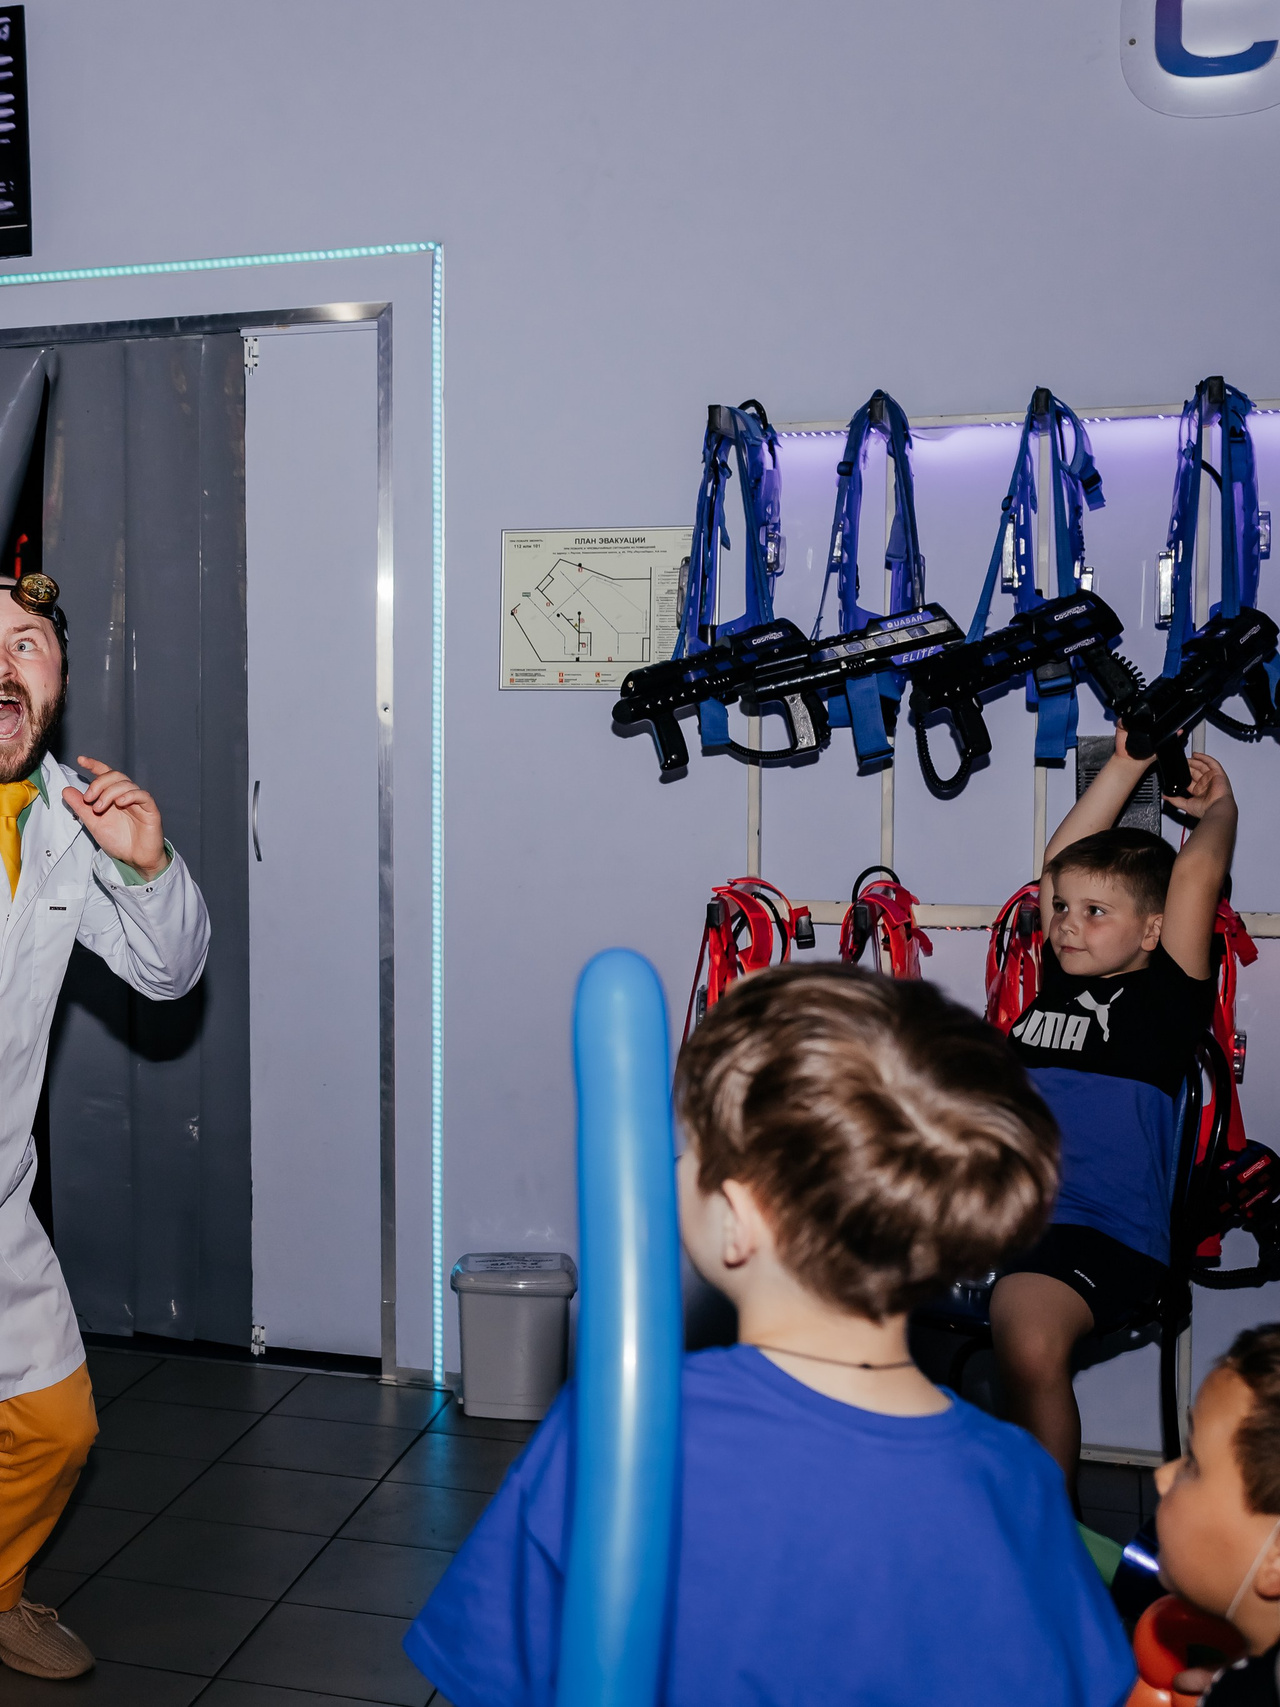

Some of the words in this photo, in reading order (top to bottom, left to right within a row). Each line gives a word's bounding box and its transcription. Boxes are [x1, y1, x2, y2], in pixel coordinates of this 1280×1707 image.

[574, 537, 598, 545] ПЛАН
[598, 536, 646, 545] ЭВАКУАЦИИ
[886, 614, 923, 628] QUASAR
[902, 646, 935, 663] ELITE
